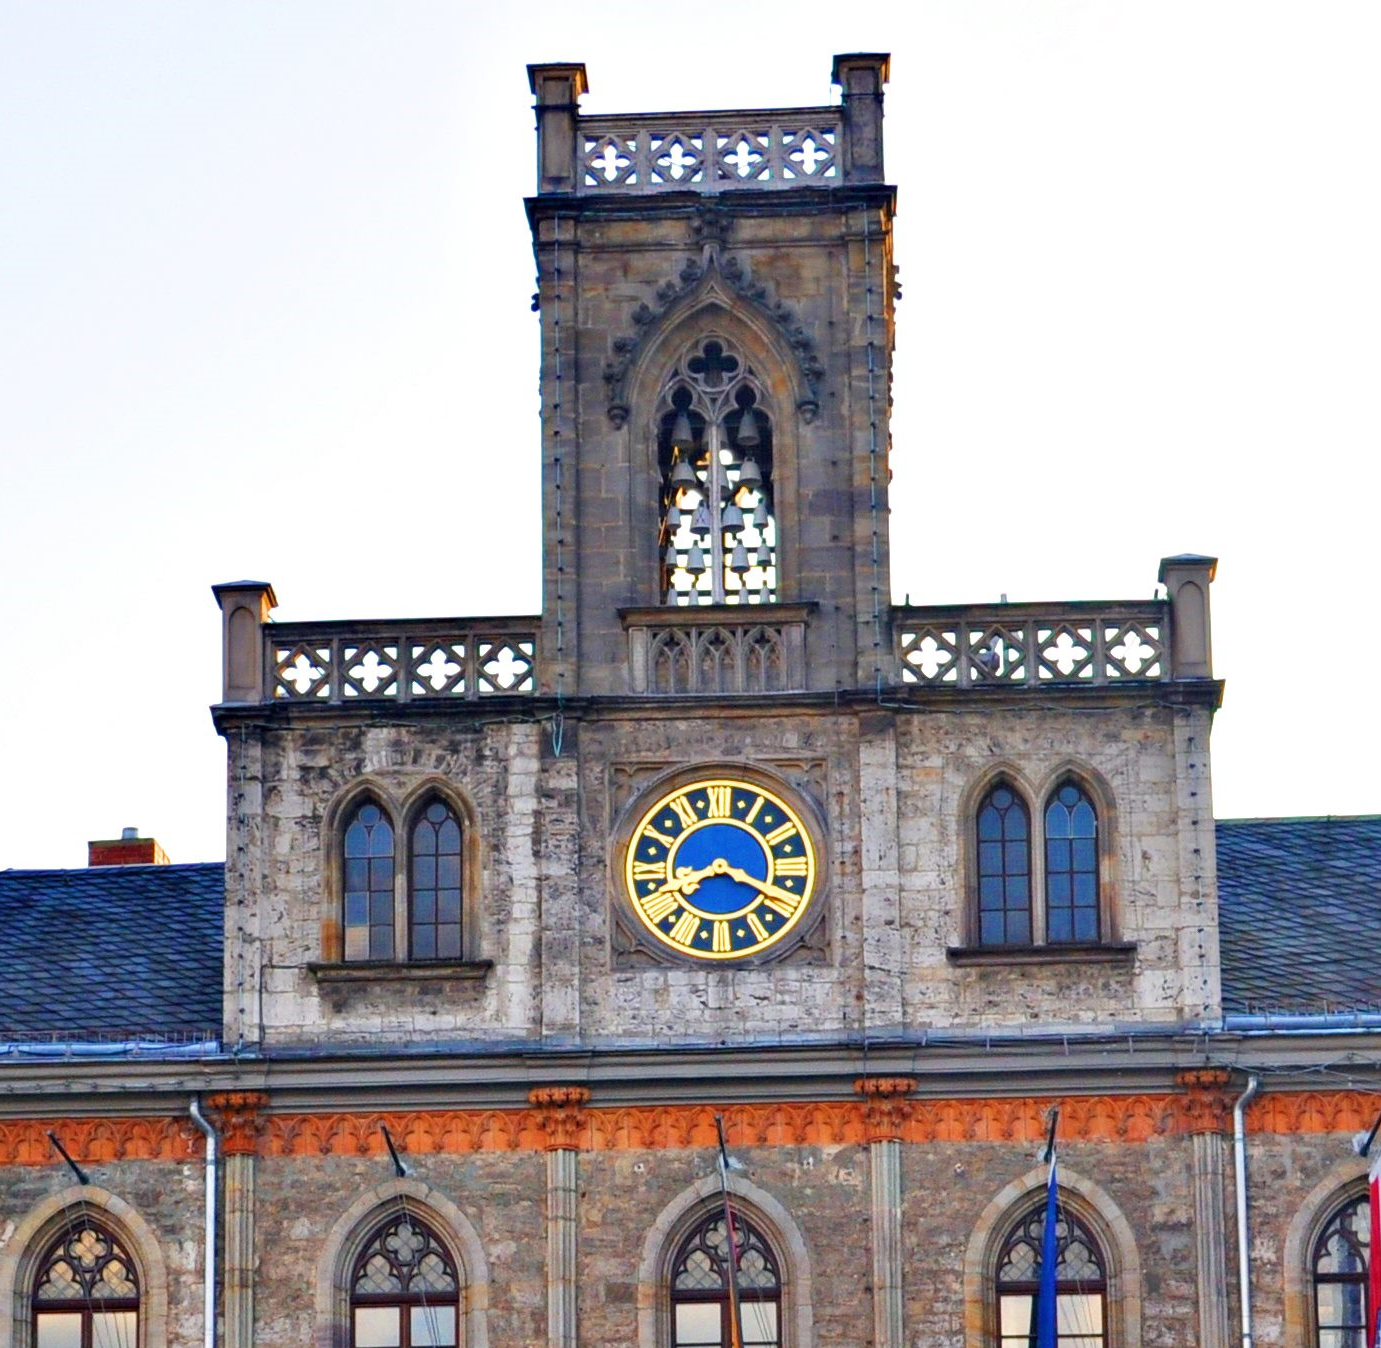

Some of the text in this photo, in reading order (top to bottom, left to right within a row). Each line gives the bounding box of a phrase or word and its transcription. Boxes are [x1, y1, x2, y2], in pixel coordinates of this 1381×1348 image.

[669, 795, 699, 829] XI
[706, 786, 732, 818] XII
[745, 795, 765, 824] I
[643, 824, 675, 848] X
[765, 821, 797, 846] II
[633, 861, 666, 880] IX
[774, 856, 807, 876] III
[712, 920, 732, 952] VI
